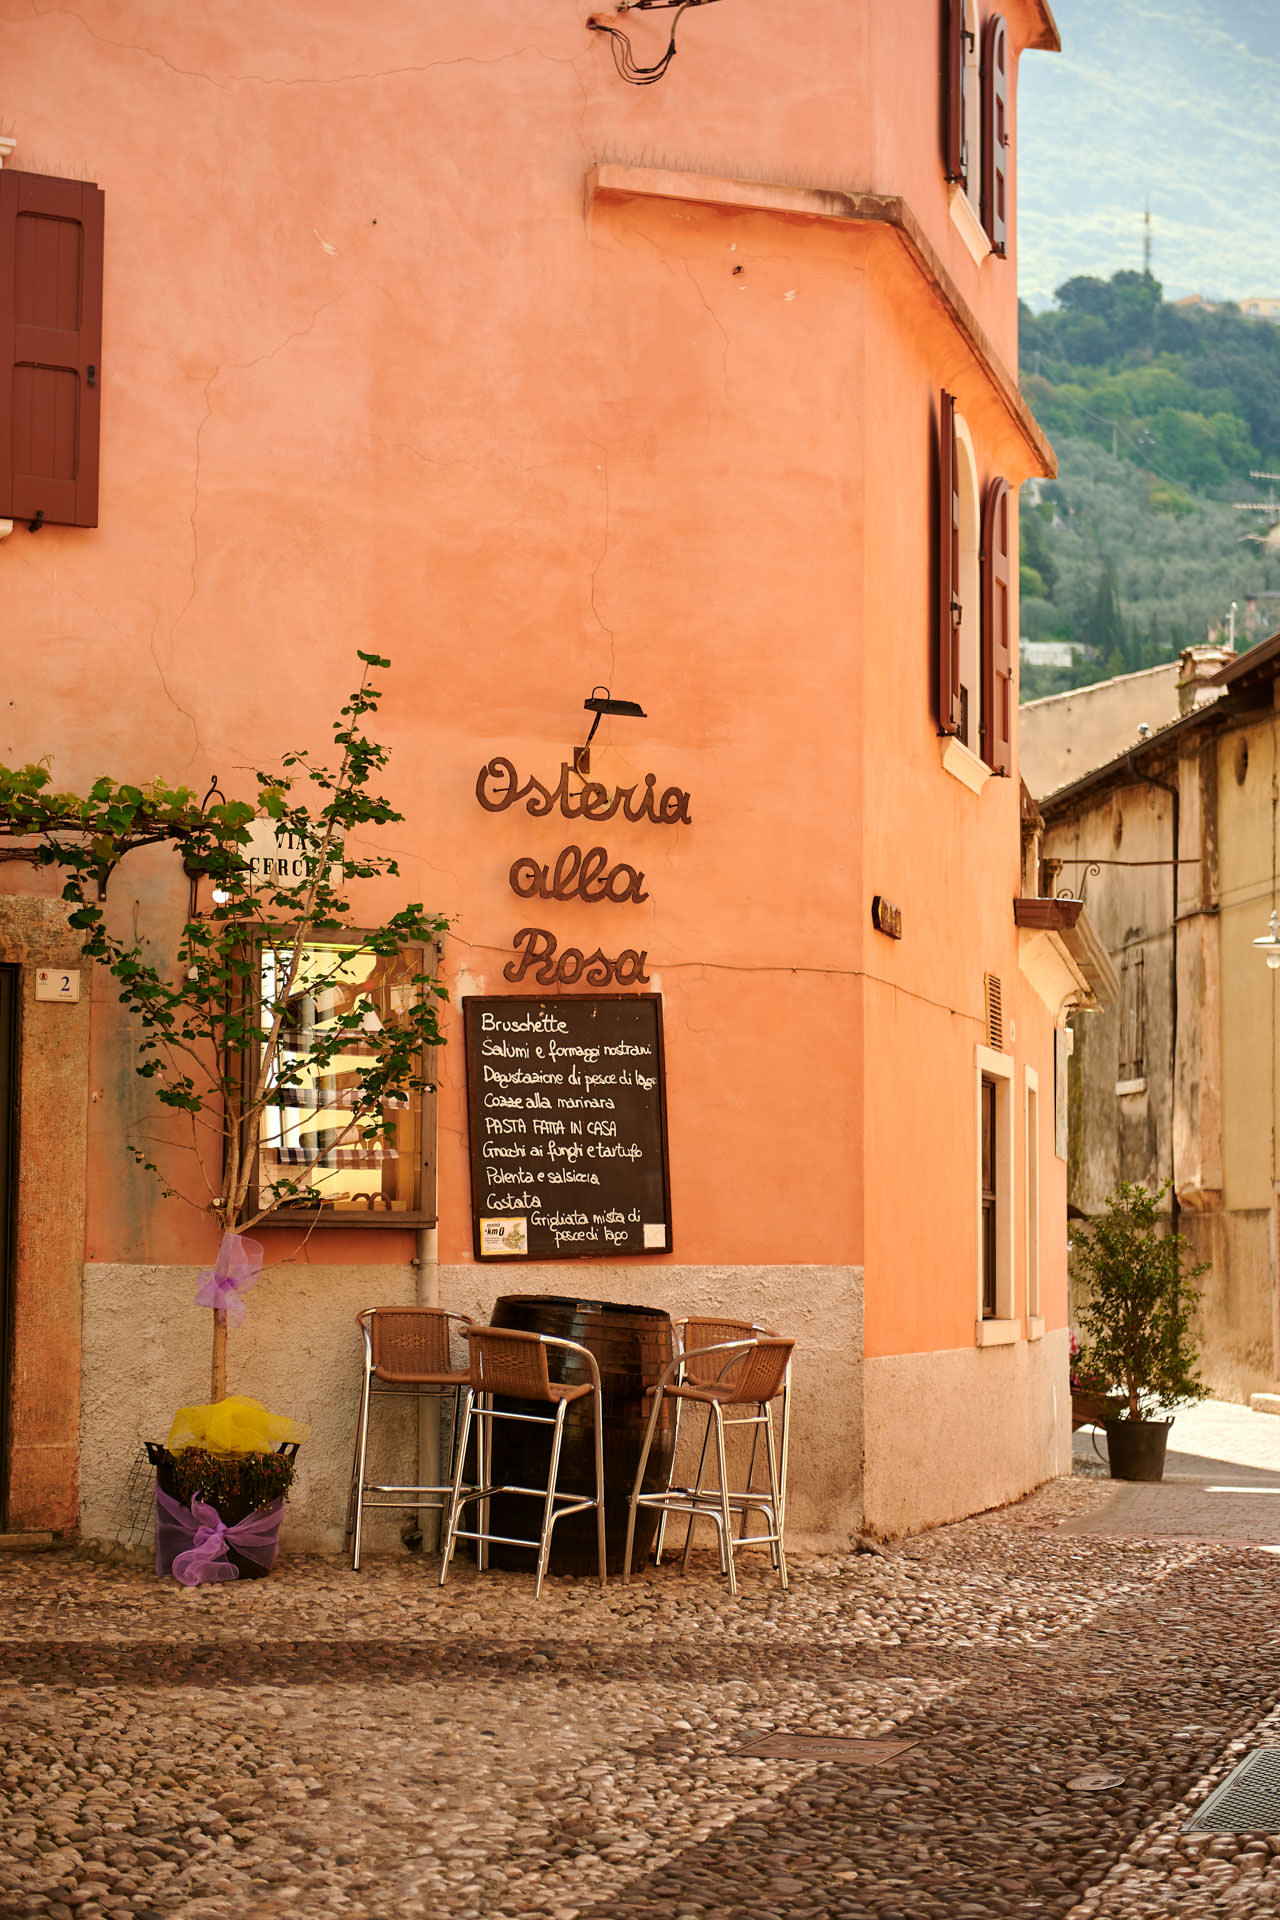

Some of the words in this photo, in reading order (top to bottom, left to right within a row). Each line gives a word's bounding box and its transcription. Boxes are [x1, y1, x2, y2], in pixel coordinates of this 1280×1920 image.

[475, 756, 692, 825] Osteria
[274, 831, 308, 851] VIA
[508, 844, 650, 904] alla
[502, 927, 650, 987] Rosa
[60, 975, 71, 992] 2
[481, 1012, 569, 1034] Bruschette
[481, 1039, 530, 1059] Salumi
[535, 1046, 546, 1059] e
[548, 1039, 601, 1063] formaggi
[603, 1039, 653, 1056] nostrani
[483, 1064, 564, 1089] Degustazione
[567, 1063, 582, 1086] di
[584, 1073, 618, 1093] pesce
[618, 1068, 633, 1085] di
[525, 1092, 553, 1109] alla
[557, 1095, 616, 1110] marinara
[485, 1116, 527, 1134] PASTA
[532, 1118, 566, 1136] FATTA
[570, 1119, 583, 1136] IN
[586, 1120, 617, 1137] CASA
[482, 1140, 526, 1158] Gnocchi
[529, 1144, 544, 1158] ai
[546, 1139, 584, 1164] funghi
[586, 1145, 596, 1159] e
[595, 1141, 643, 1163] tartufo
[486, 1166, 535, 1186] Polenta
[537, 1171, 545, 1182] e
[547, 1167, 601, 1186] salsiccia
[486, 1190, 542, 1210] Costata
[530, 1210, 590, 1232] Grigliata
[592, 1207, 626, 1225] mista
[627, 1207, 642, 1223] di
[554, 1230, 586, 1249] pesce
[585, 1226, 599, 1241] di
[604, 1225, 629, 1246] lago
